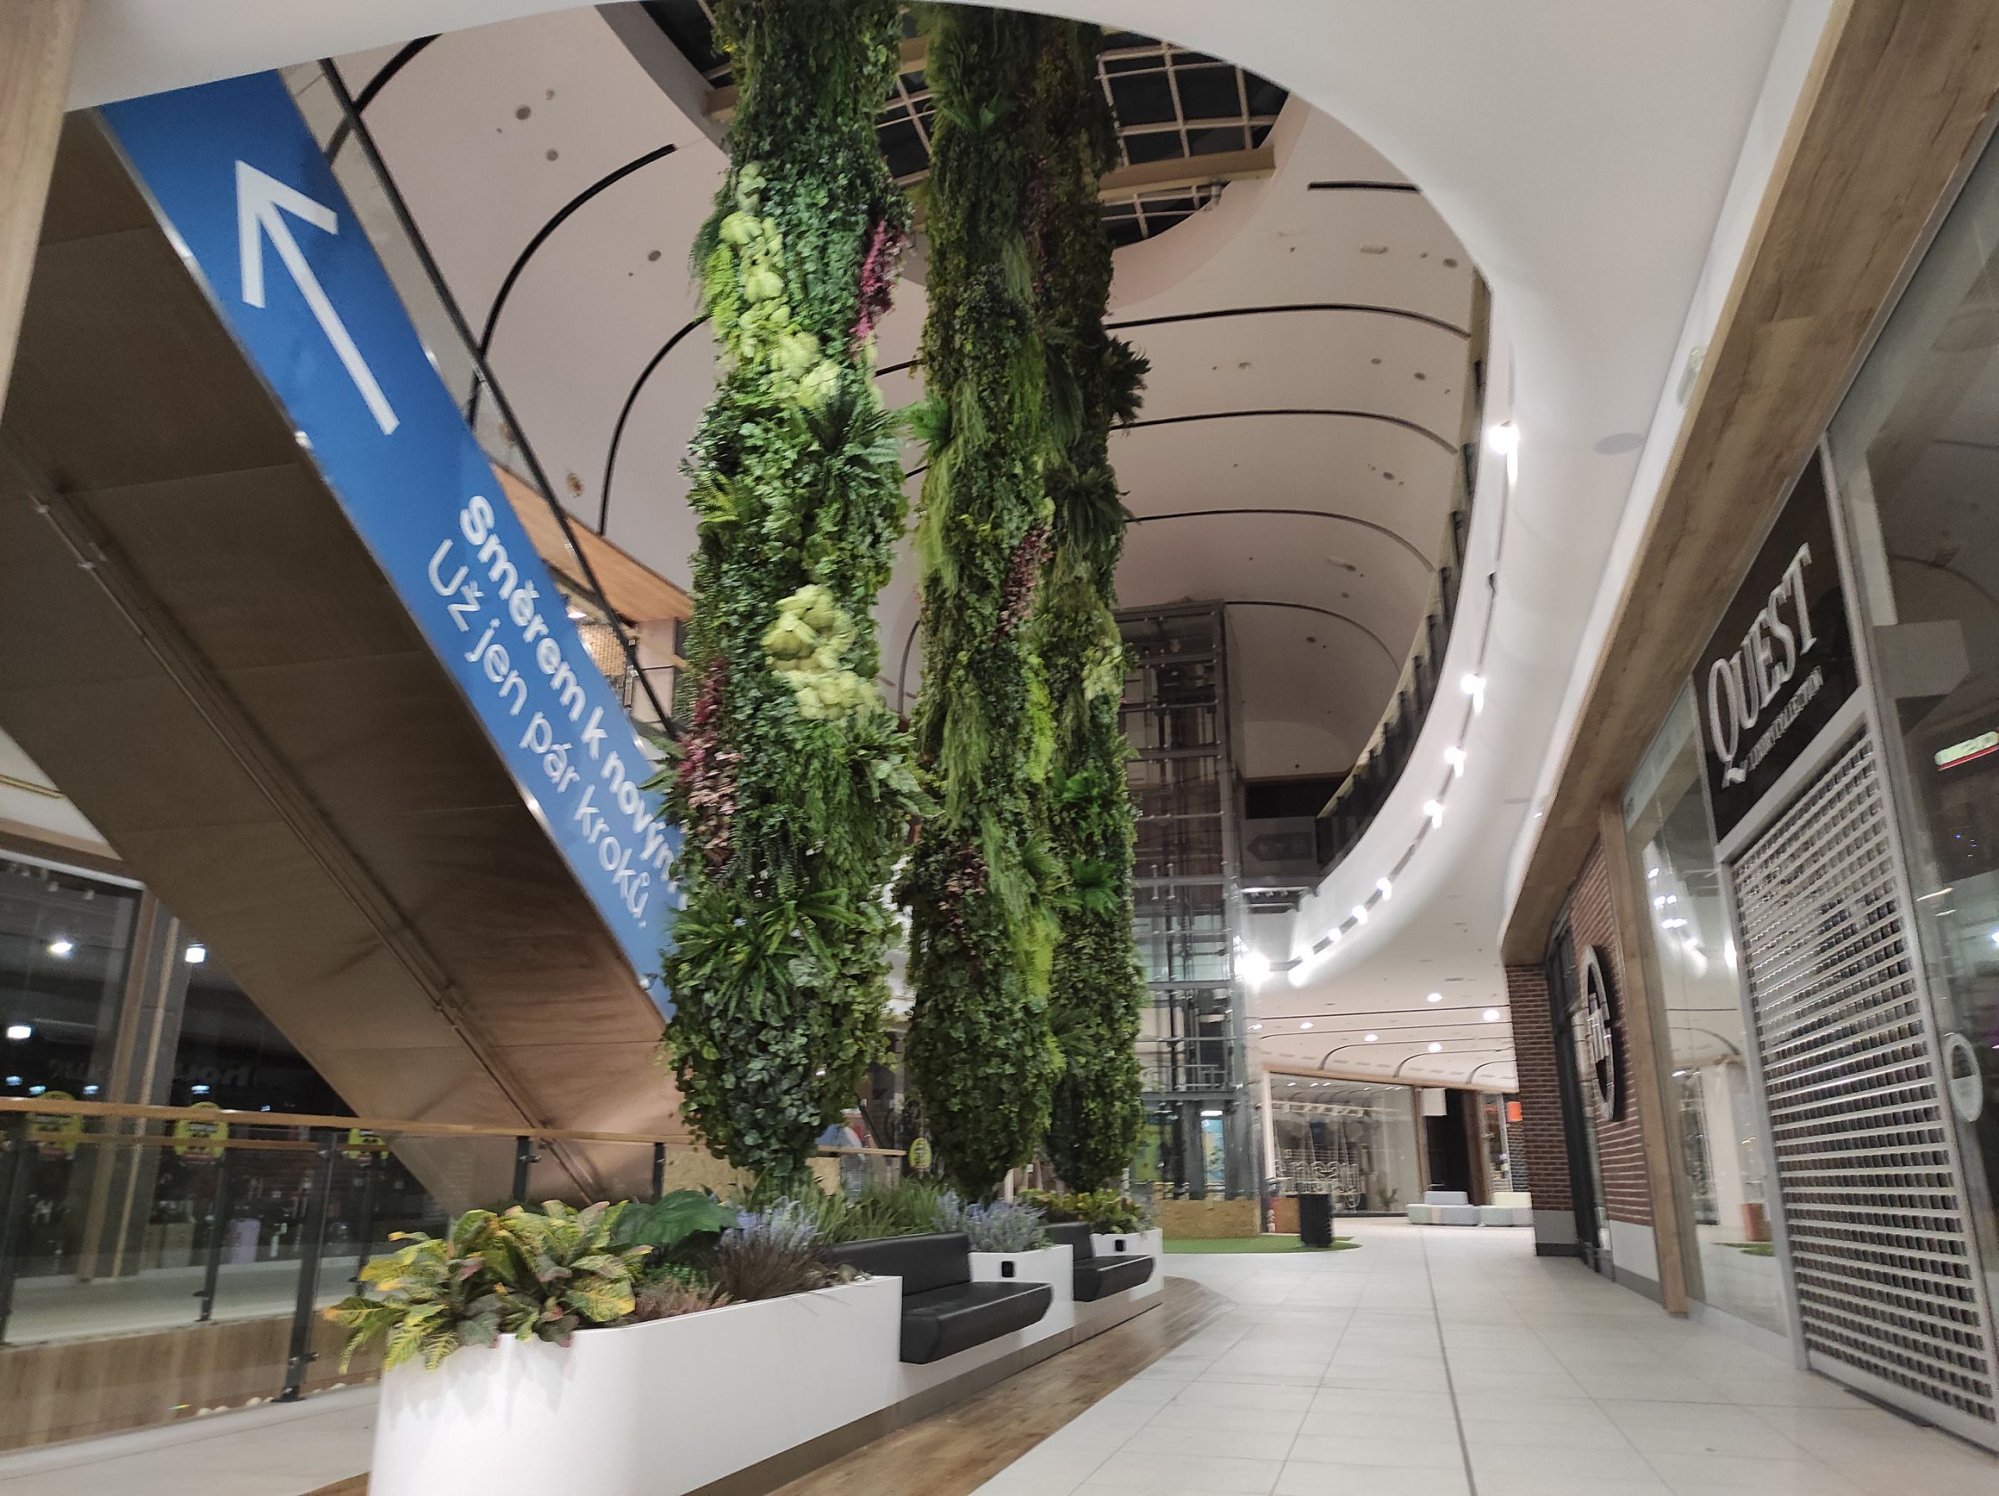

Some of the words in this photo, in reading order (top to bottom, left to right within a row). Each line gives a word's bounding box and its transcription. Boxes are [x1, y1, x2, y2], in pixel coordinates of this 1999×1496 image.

[428, 538, 484, 631] Už
[464, 618, 528, 716] jen
[519, 711, 579, 793] pár
[574, 784, 651, 928] kroků.
[460, 496, 586, 721] Směrem
[581, 706, 608, 759] k
[1708, 542, 1817, 789] QUEST
